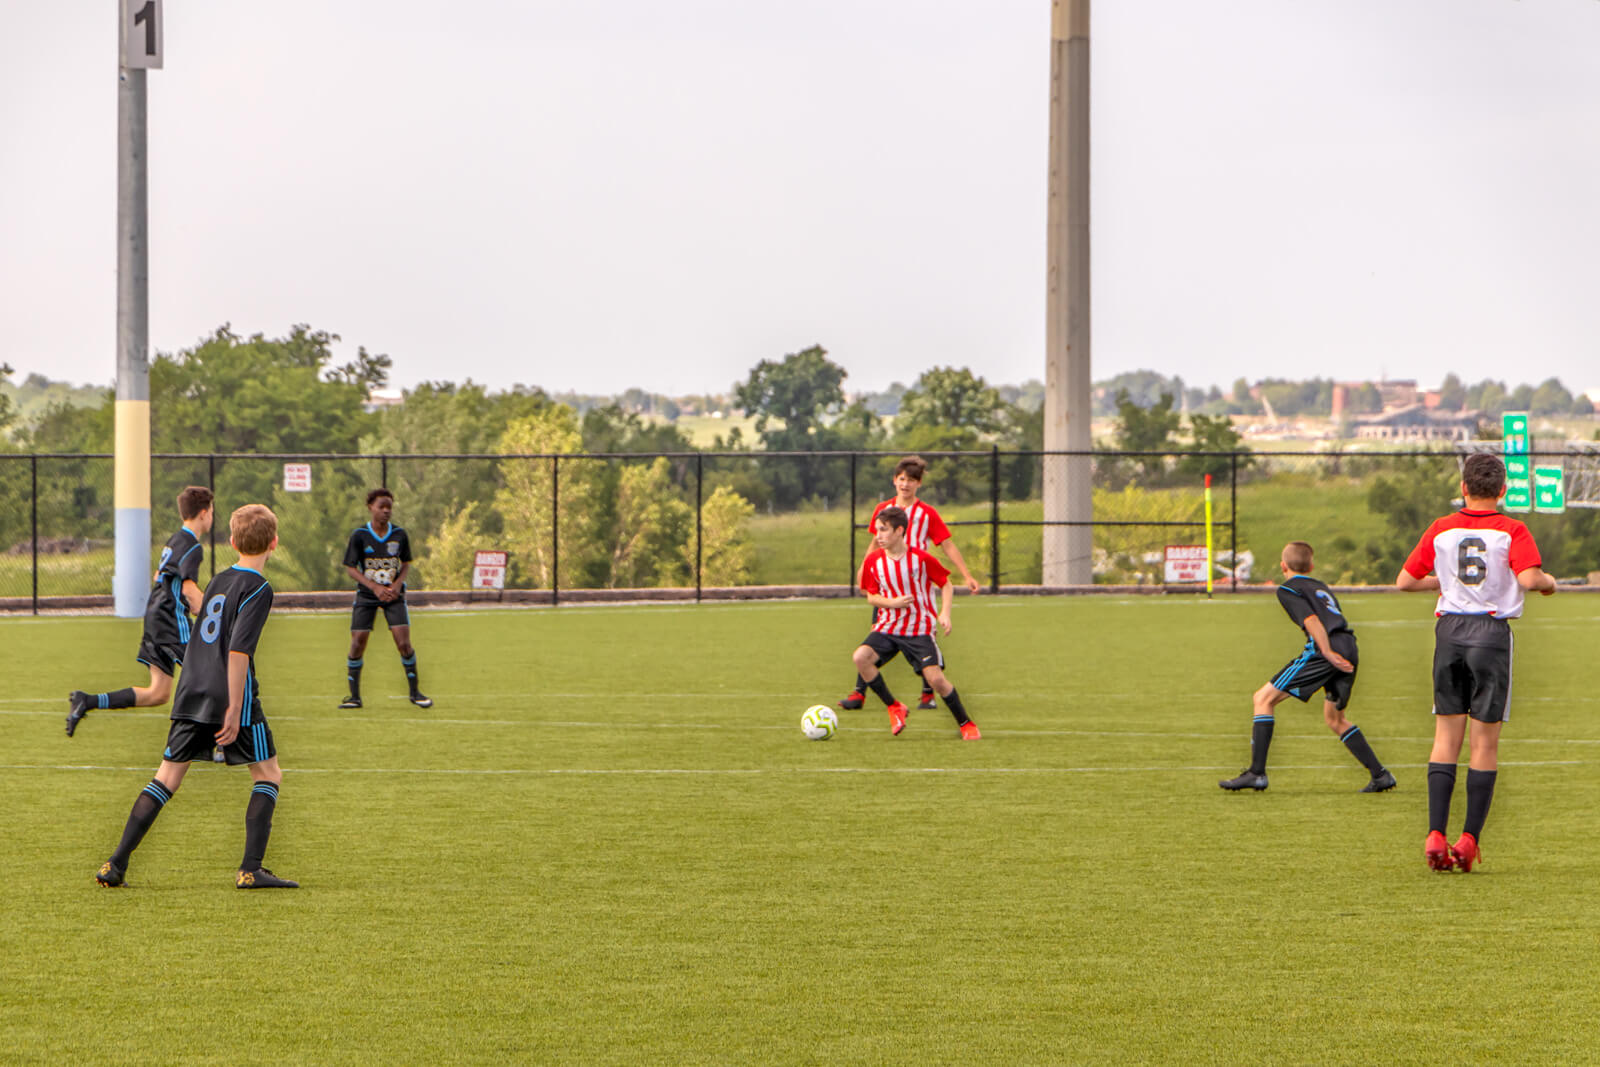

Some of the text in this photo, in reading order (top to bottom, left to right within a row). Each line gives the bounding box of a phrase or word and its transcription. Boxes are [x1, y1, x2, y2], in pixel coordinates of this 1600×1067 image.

[134, 0, 156, 56] 1
[1458, 537, 1486, 585] 6
[200, 594, 226, 644] 8
